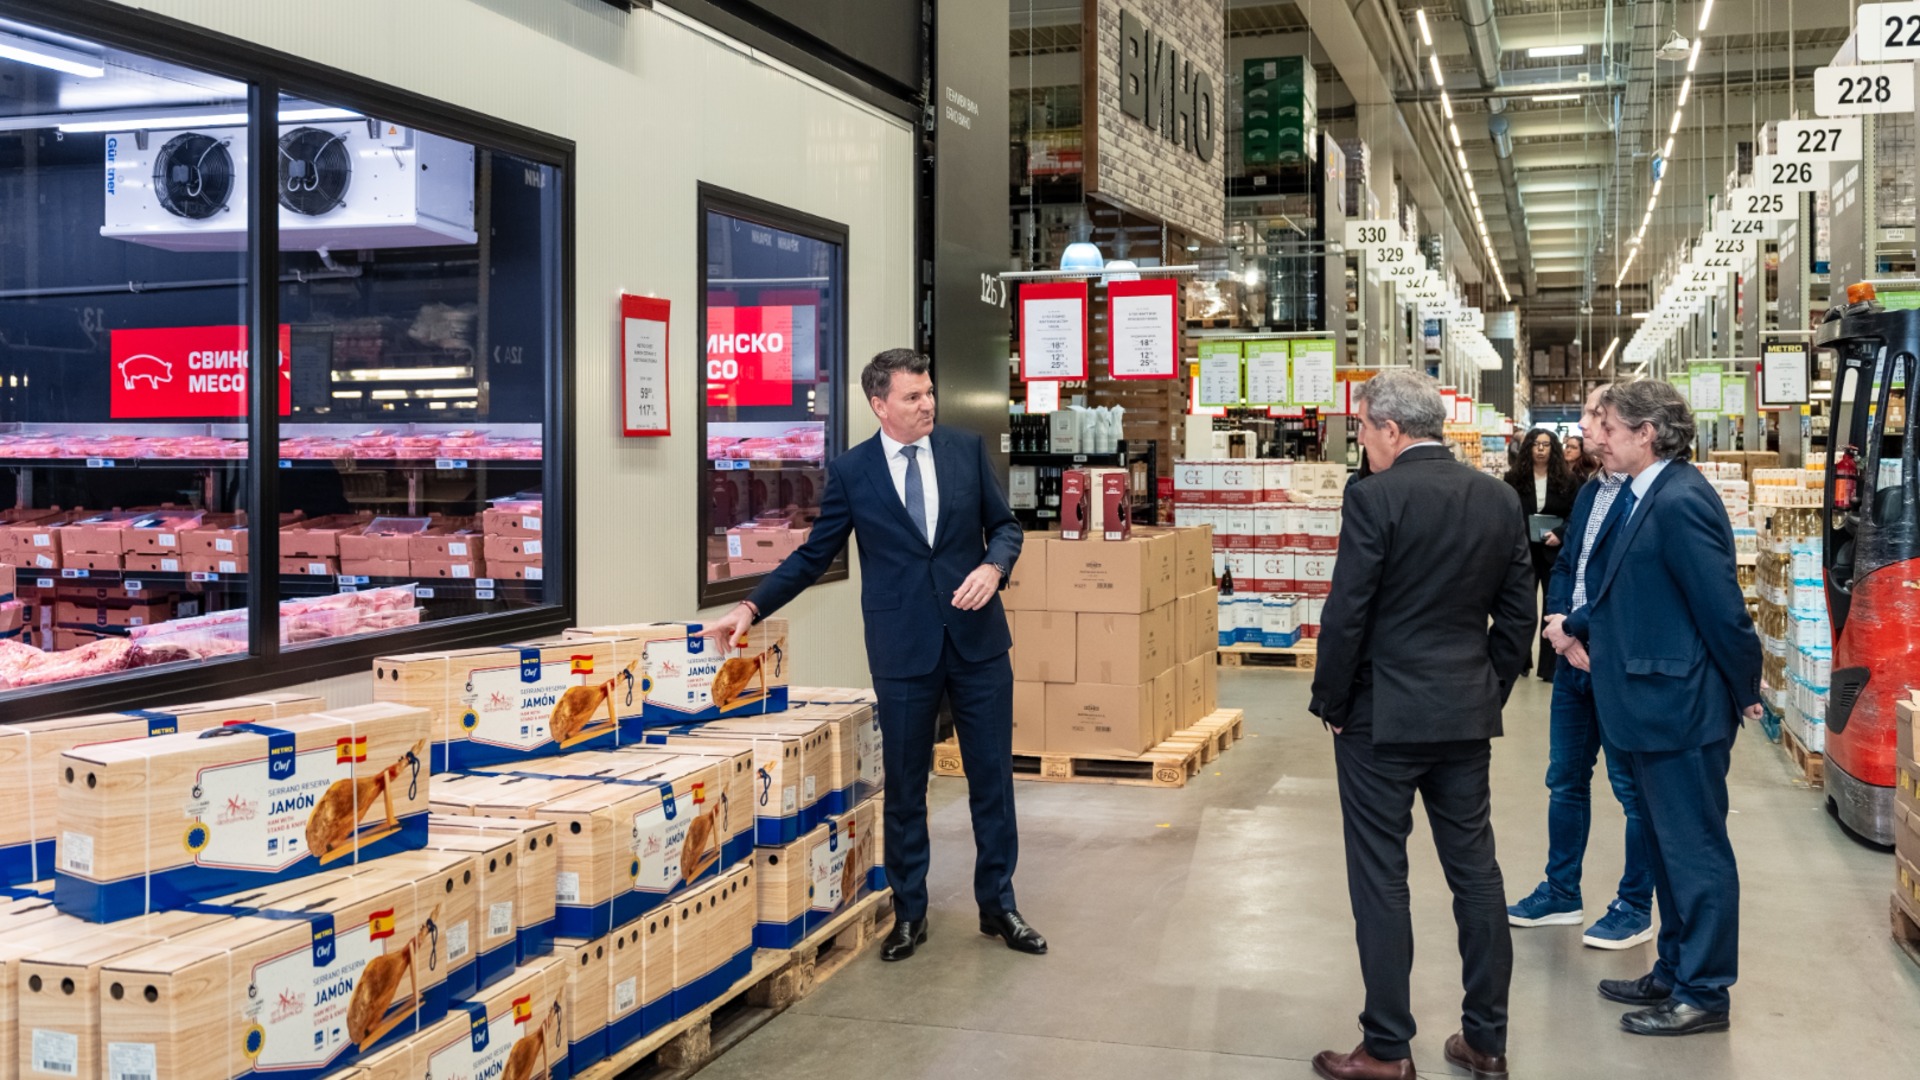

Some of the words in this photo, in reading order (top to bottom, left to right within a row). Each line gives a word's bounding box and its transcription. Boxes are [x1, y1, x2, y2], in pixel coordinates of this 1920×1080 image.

[1119, 8, 1215, 163] ВИНО
[1837, 76, 1891, 104] 228
[1797, 129, 1842, 153] 227
[1772, 162, 1812, 184] 226
[1747, 195, 1783, 213] 225
[1358, 227, 1386, 243] 330
[1731, 219, 1764, 234] 224
[1377, 247, 1403, 262] 329
[1715, 239, 1744, 253] 223
[981, 273, 998, 305] 12Б
[1768, 345, 1802, 353] METRO
[188, 350, 282, 370] СВИН
[189, 374, 245, 393] МЕСО
[688, 664, 717, 677] JAMÓN
[521, 693, 555, 709] JAMÓN
[151, 727, 175, 736] METRO
[271, 746, 293, 755] METRO
[273, 760, 291, 772] Chef
[268, 784, 300, 798] SERRANO
[301, 778, 331, 790] RESERVA
[268, 793, 315, 816] JAMÓN
[314, 928, 333, 941] METRO
[316, 943, 332, 958] Chef
[313, 968, 340, 986] SERRANO
[341, 959, 365, 976] RESERVA
[314, 978, 353, 1007] JAMÓN
[475, 1060, 502, 1080] JAMÓN
